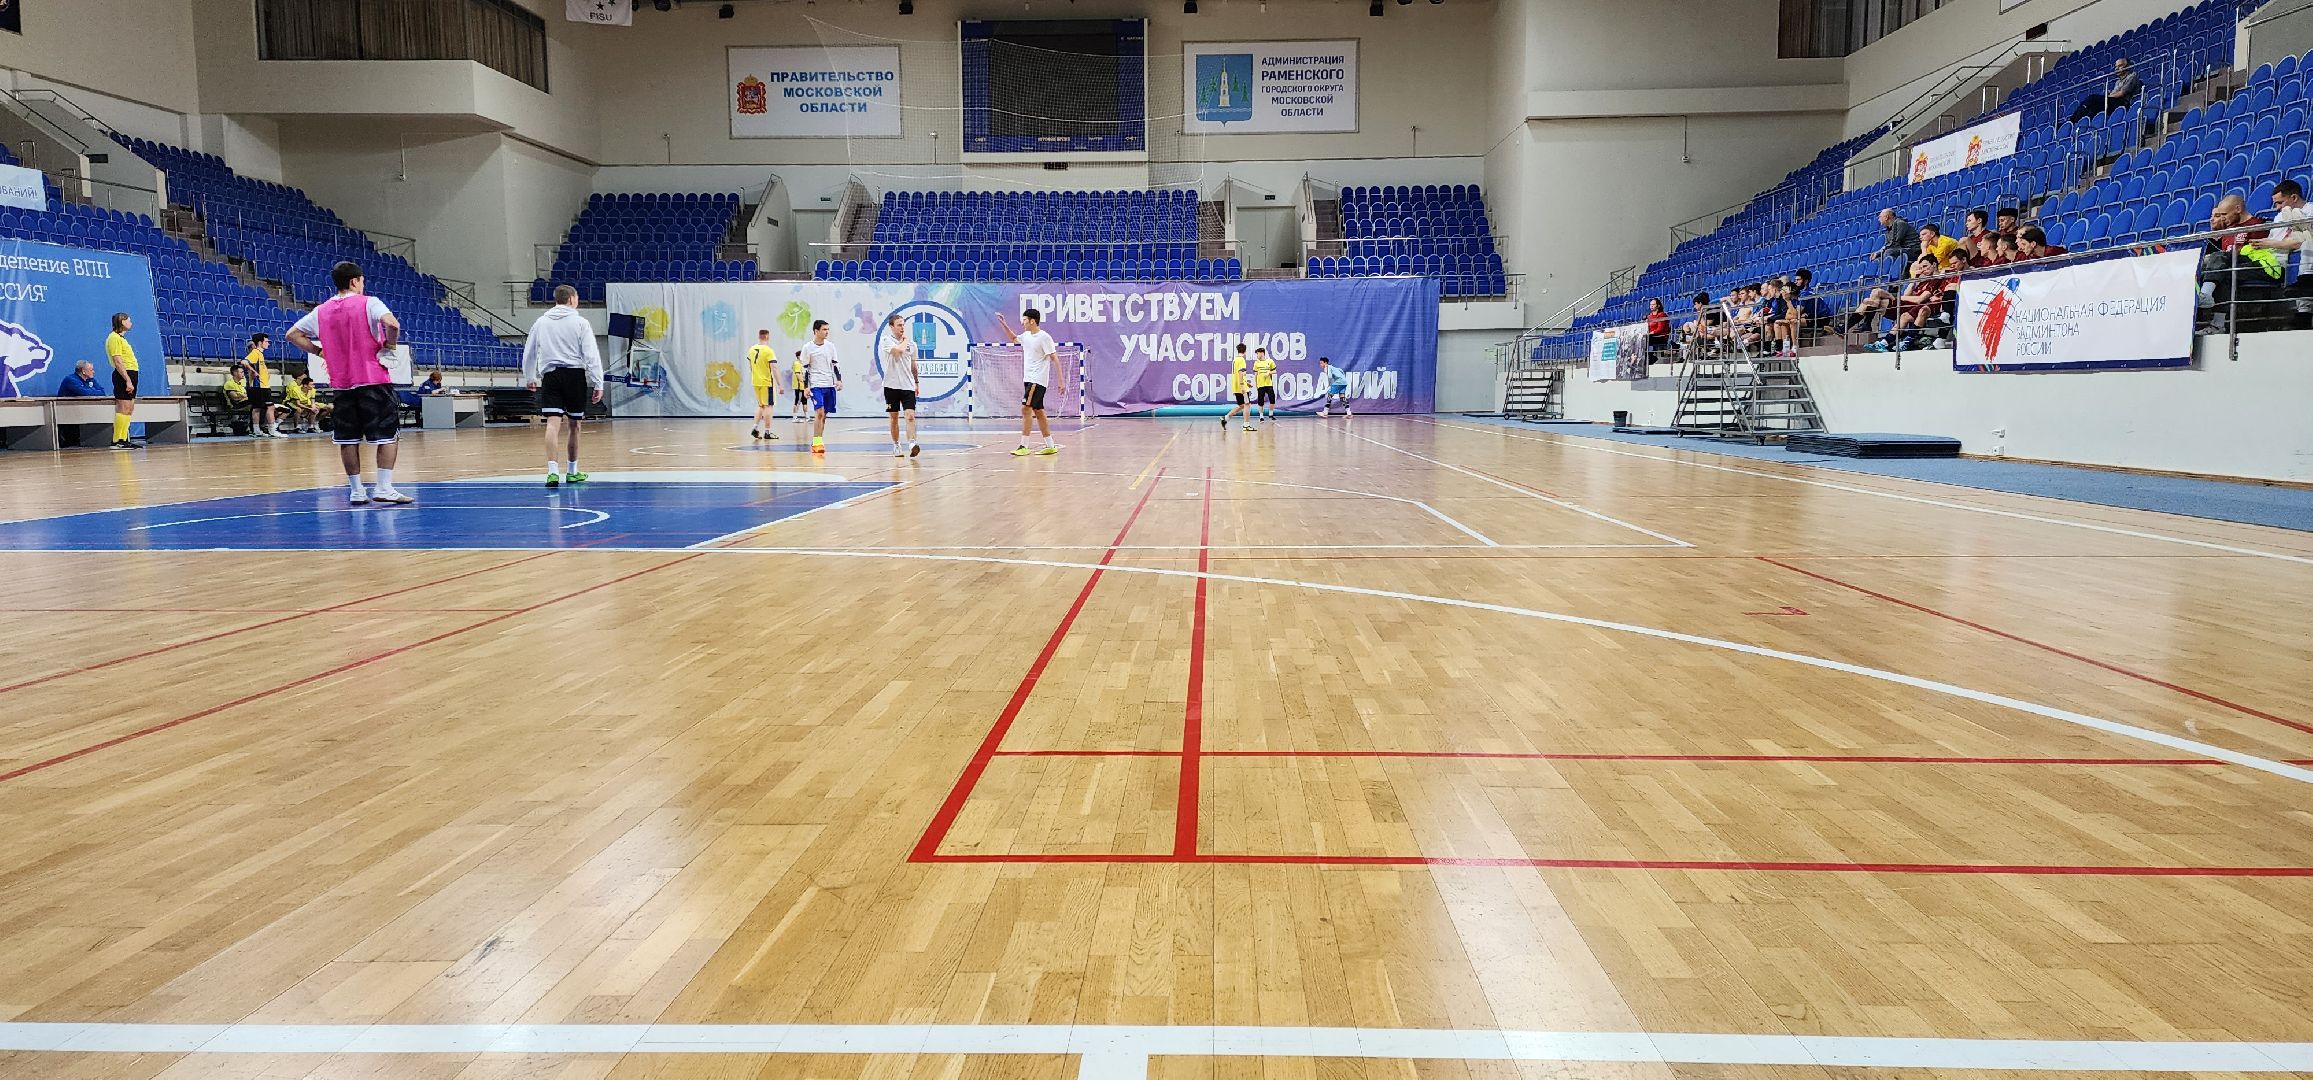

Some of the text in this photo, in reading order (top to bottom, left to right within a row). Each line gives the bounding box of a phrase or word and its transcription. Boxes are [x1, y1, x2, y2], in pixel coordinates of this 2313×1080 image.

[589, 12, 613, 21] FISU
[1261, 55, 1345, 66] АДМИНИСТРАЦИЯ
[770, 71, 894, 83] ПРАВИТЕЛЬСТВО
[1261, 68, 1344, 81] РАМЕНСКОГО
[783, 84, 882, 98] МОСКОВСКОЙ
[1261, 84, 1344, 94] ГОРОДСКОГО ОКРУГА
[1271, 94, 1334, 105] МОСКОВСКОЙ
[799, 102, 868, 113] ОБЛАСТИ
[1280, 107, 1324, 117] ОБЛАСТИ
[72, 258, 111, 279] ВПП
[1019, 292, 1240, 323] ПРИВЕТСТВУЕМ
[2015, 295, 2166, 323] НАЦИОНАЛЬНАЯ ФЕДЕРАЦИЯ
[2016, 322, 2080, 341] БАДМИНТОНА
[1120, 332, 1307, 362] УЧАСТНИКОВ
[2016, 341, 2052, 356] РОССИИ
[753, 348, 760, 365] 7
[1172, 366, 1398, 402] СОРВОВАИЙ!
